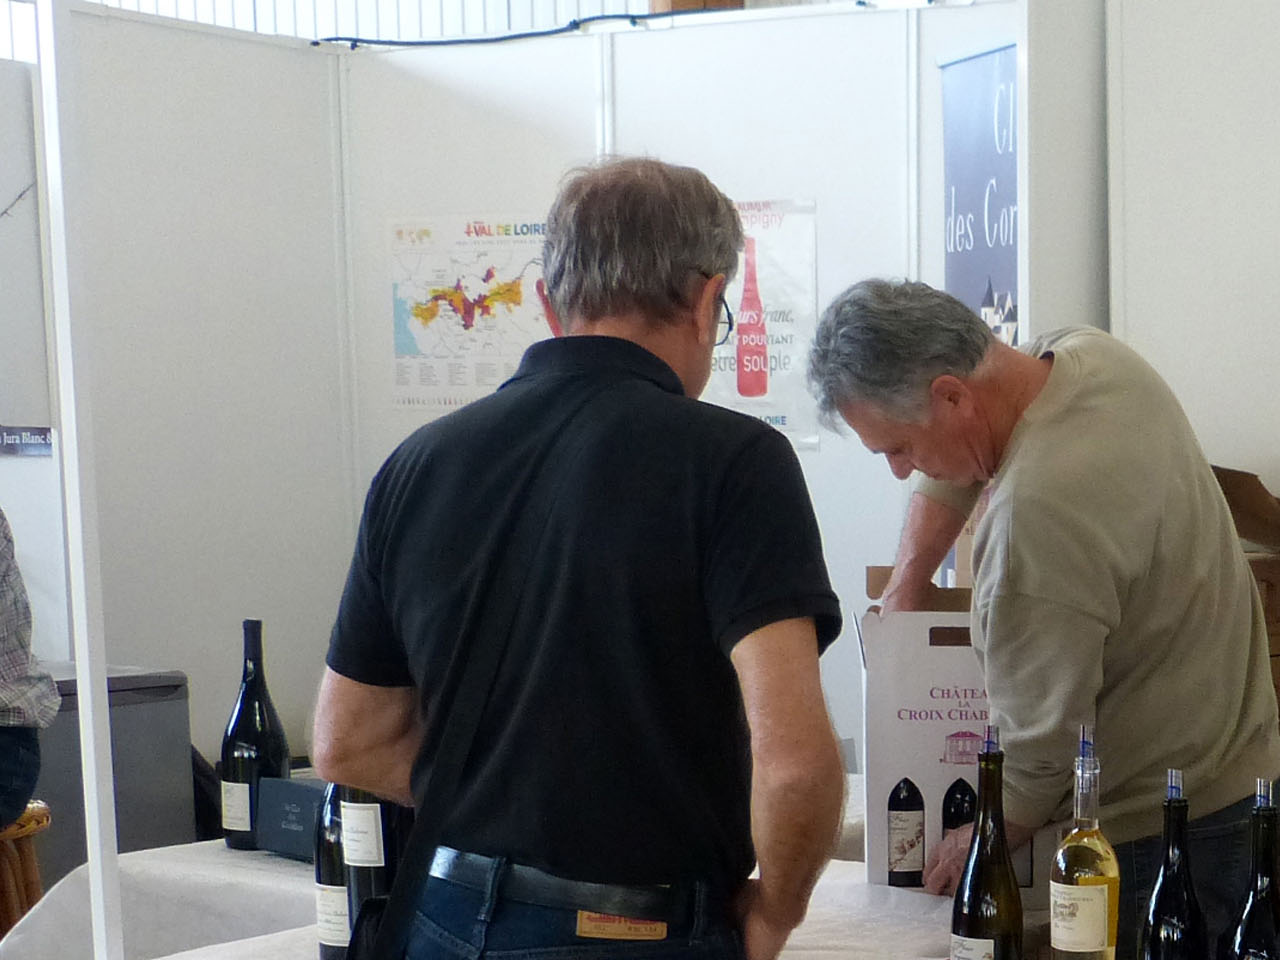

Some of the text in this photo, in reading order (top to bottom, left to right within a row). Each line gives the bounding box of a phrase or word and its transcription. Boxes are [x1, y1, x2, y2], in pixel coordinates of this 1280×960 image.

[740, 213, 784, 229] mpigny
[946, 186, 974, 252] des
[474, 224, 546, 236] VAL DE LOIRE
[742, 334, 794, 346] POURTANT
[22, 432, 45, 444] Blanc
[929, 684, 988, 700] CHÂTEA
[958, 700, 971, 708] LA
[897, 708, 989, 721] CROIX CHAB
